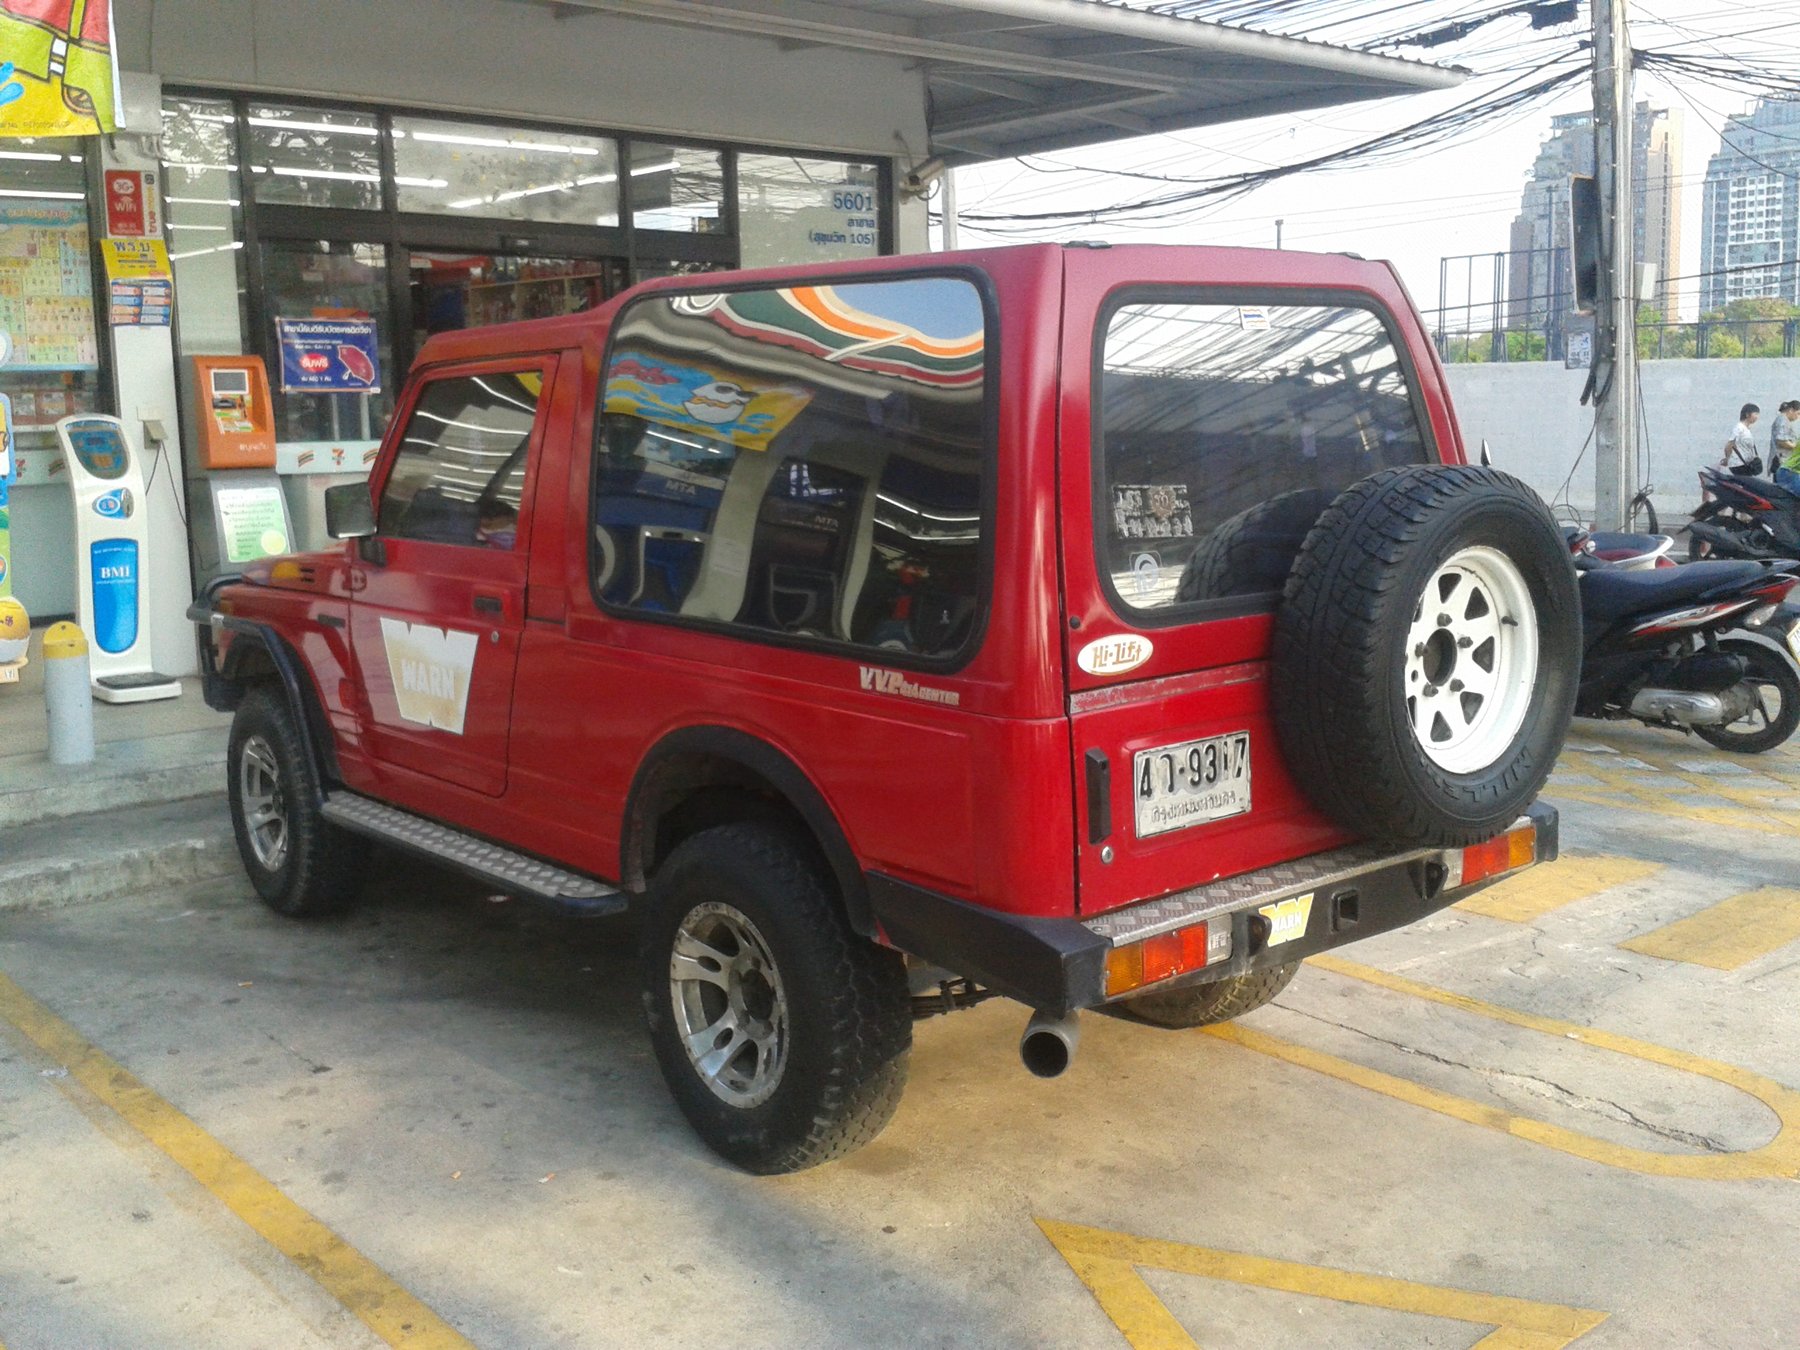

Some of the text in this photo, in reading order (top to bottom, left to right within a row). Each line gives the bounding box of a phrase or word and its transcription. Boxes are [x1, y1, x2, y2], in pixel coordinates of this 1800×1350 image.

[834, 192, 873, 211] 5601
[850, 233, 875, 246] 105)
[101, 565, 130, 578] BMI
[401, 659, 456, 700] WARN
